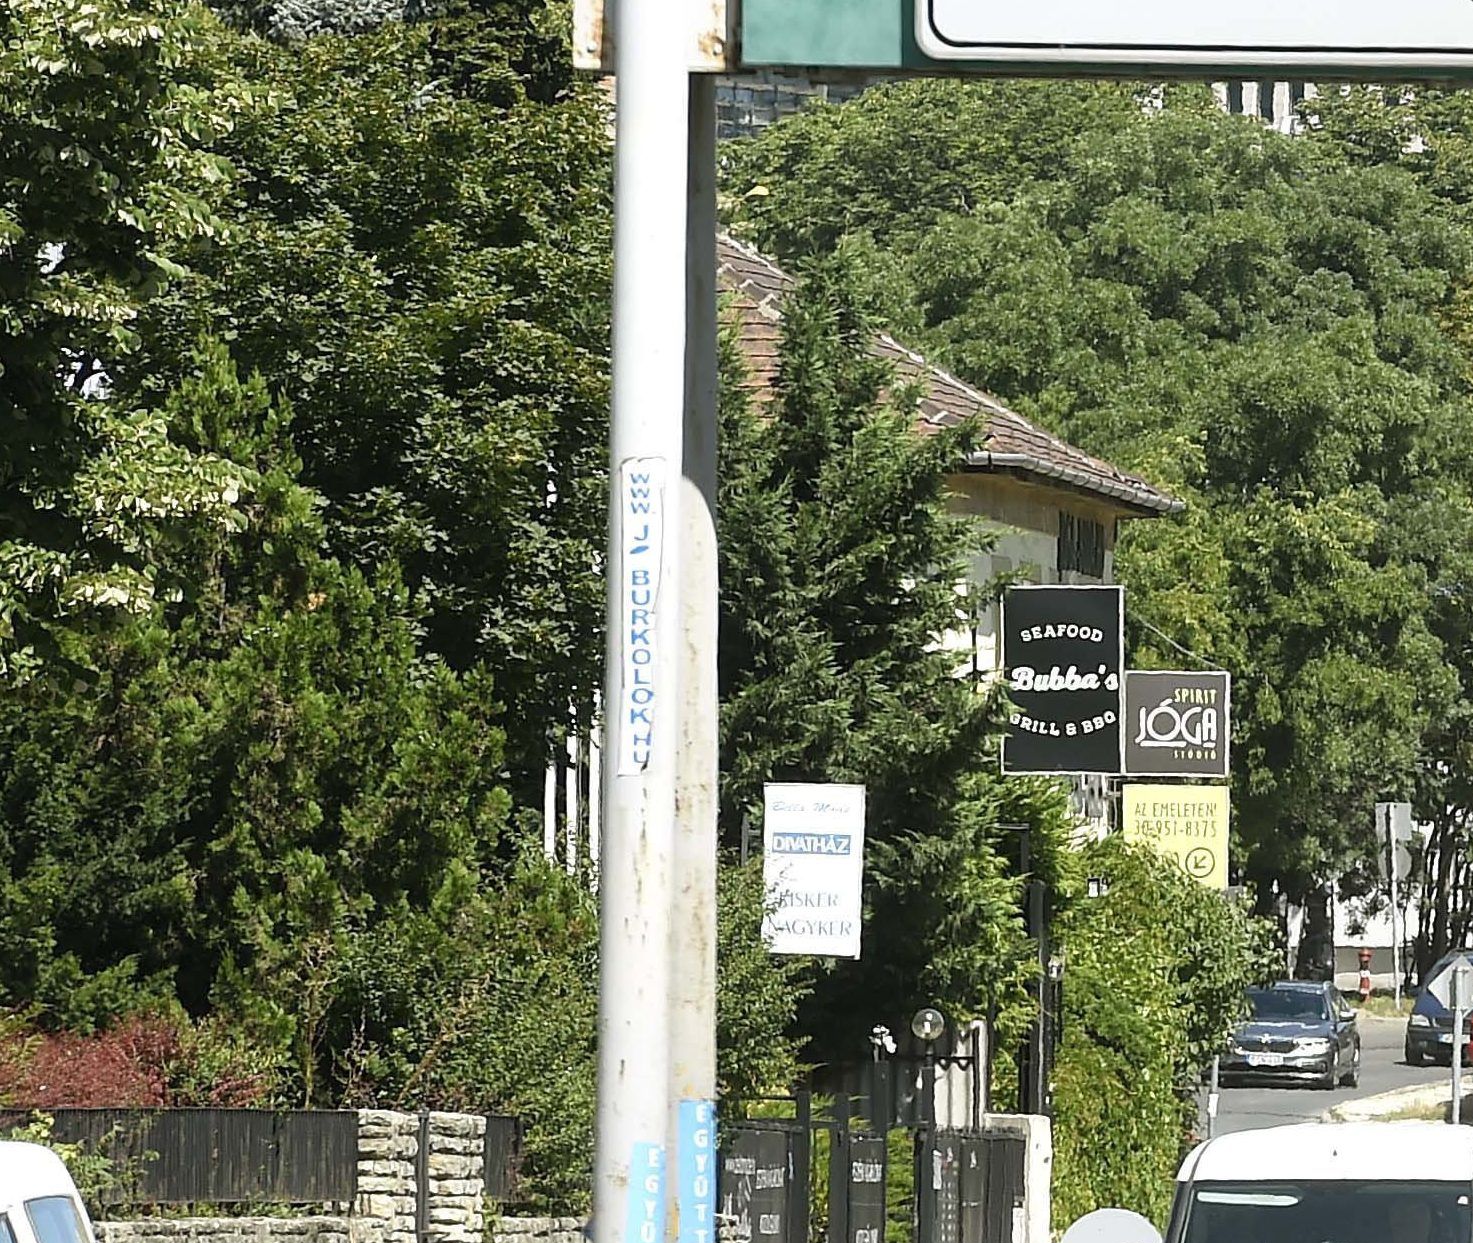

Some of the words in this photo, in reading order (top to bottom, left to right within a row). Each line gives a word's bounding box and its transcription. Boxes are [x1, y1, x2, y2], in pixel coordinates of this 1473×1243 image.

[1020, 624, 1103, 642] SEAFOOD
[1011, 665, 1119, 691] Bubba's
[1174, 688, 1217, 704] SPIRIT
[1009, 713, 1060, 737] GRILL
[1065, 722, 1077, 736] &
[1083, 711, 1117, 734] BBQ
[1135, 698, 1217, 746] JÓGA
[773, 833, 850, 854] DIVATHÁZ
